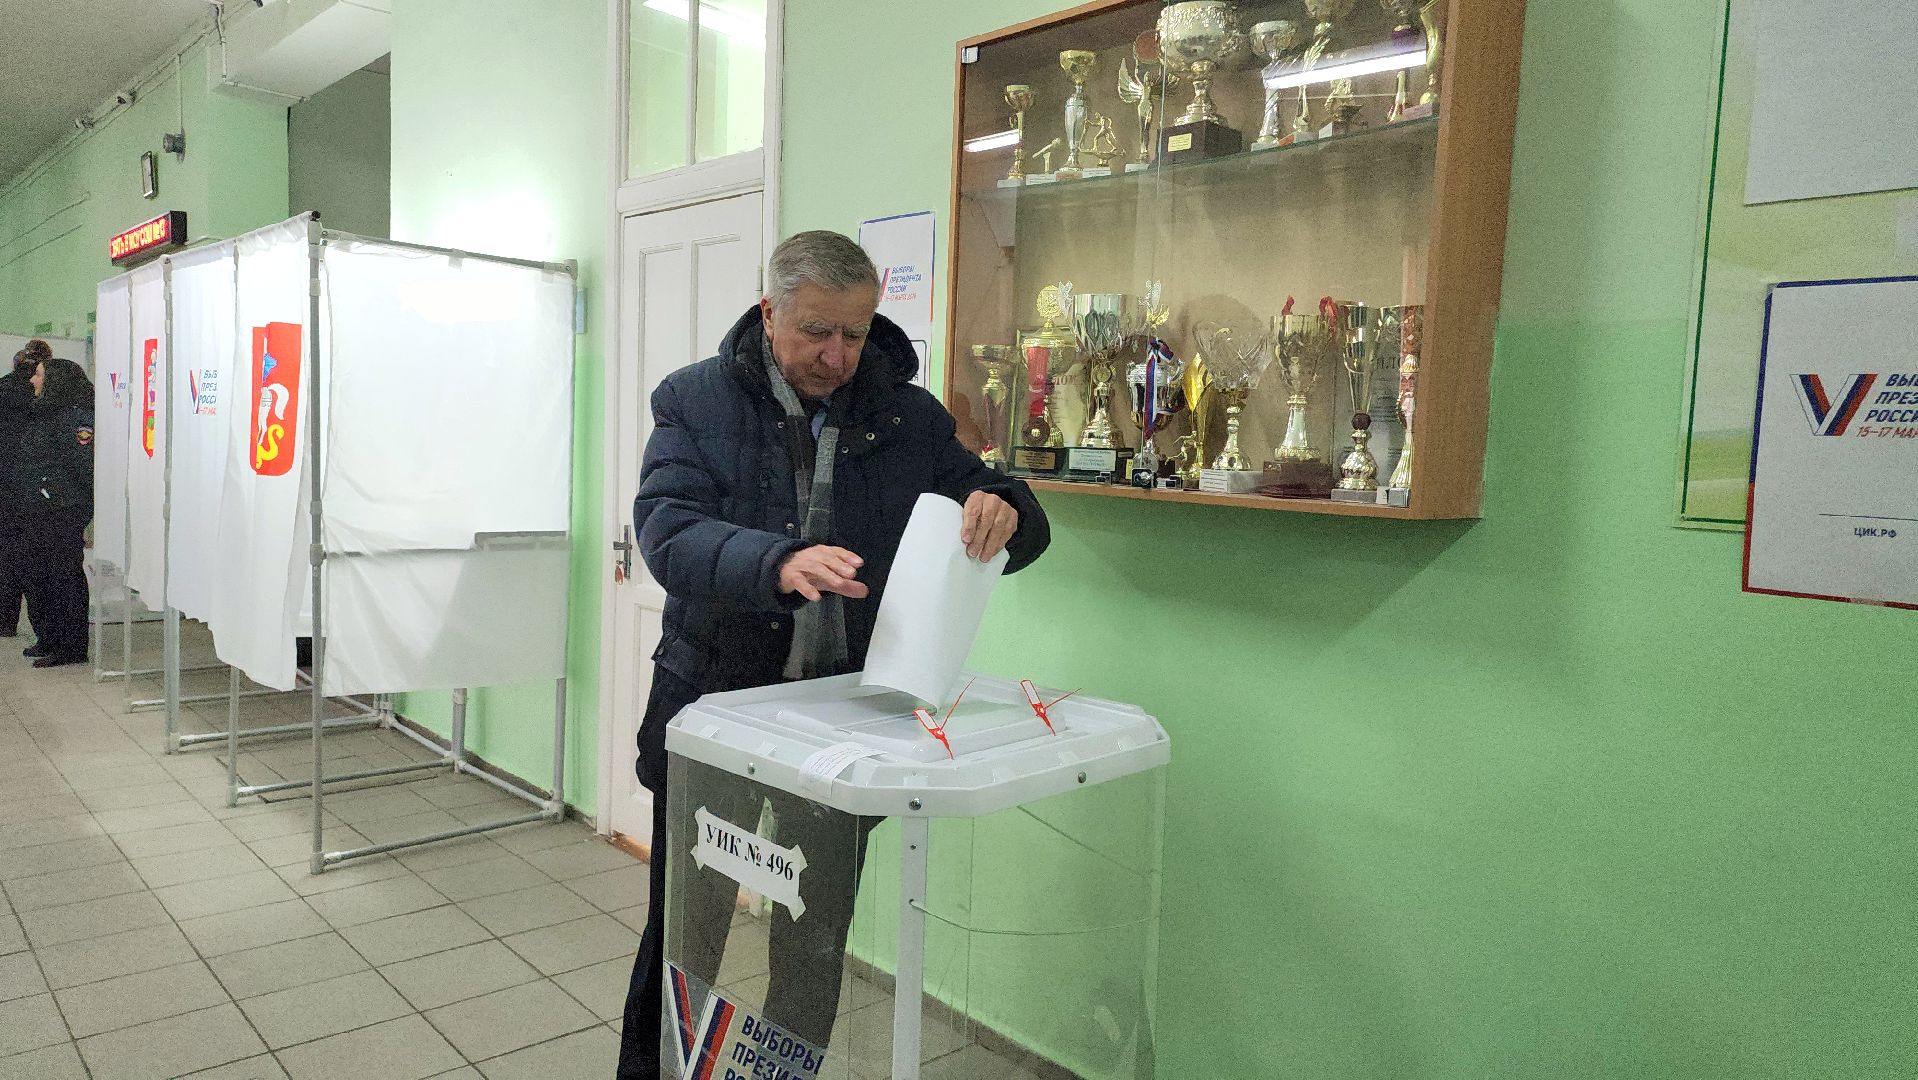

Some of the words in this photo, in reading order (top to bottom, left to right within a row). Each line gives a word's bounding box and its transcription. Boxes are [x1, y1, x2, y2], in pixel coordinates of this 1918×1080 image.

[891, 265, 916, 275] ВЫБОРЫ
[1854, 527, 1897, 538] ЦИК.РФ
[706, 822, 741, 857] УИК
[744, 841, 762, 867] №
[766, 853, 794, 881] 496
[741, 1014, 825, 1075] ВЫБОРЫ
